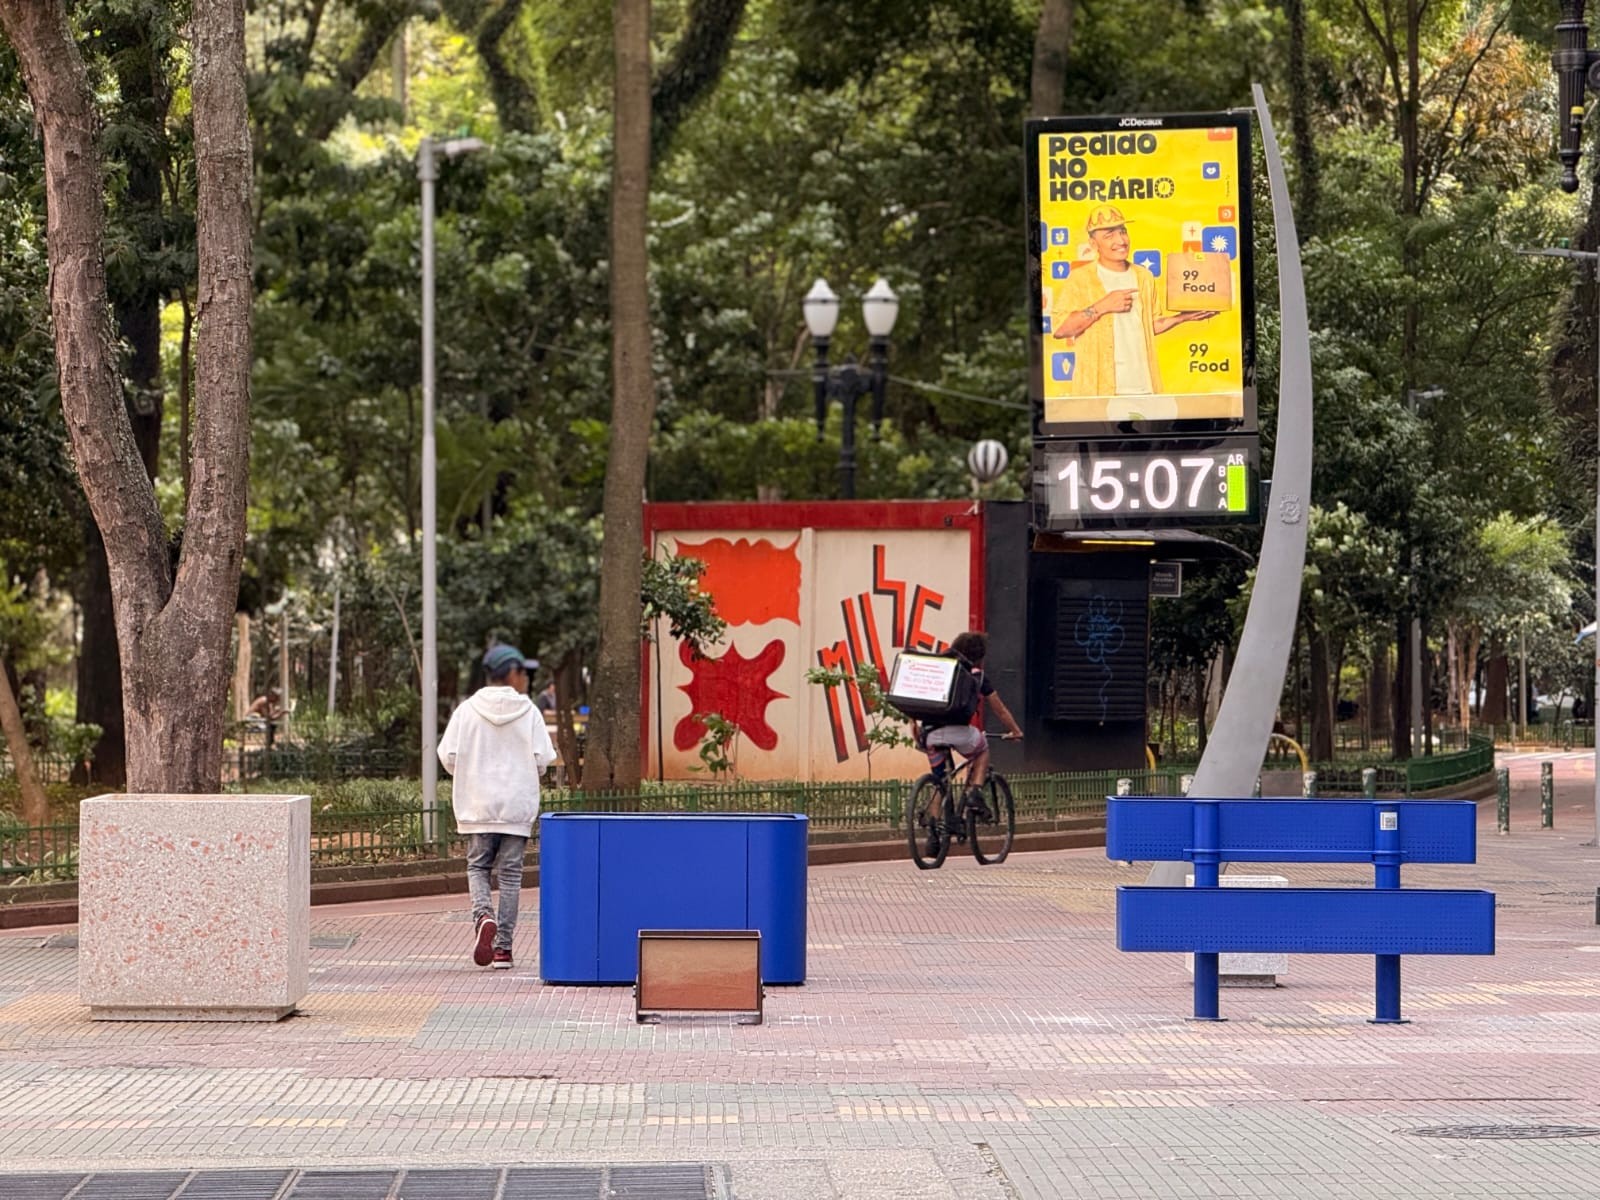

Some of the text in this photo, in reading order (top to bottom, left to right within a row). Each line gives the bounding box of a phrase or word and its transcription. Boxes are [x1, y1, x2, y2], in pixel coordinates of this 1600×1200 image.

[1118, 118, 1163, 127] JCDecaux
[1048, 158, 1087, 179] NO
[1049, 176, 1175, 202] HORÁRIO
[1182, 270, 1199, 281] 99
[1182, 282, 1216, 293] Food
[1189, 343, 1209, 358] 99
[1189, 358, 1229, 373] Food
[1227, 454, 1244, 466] AR
[1057, 457, 1215, 511] 15:07
